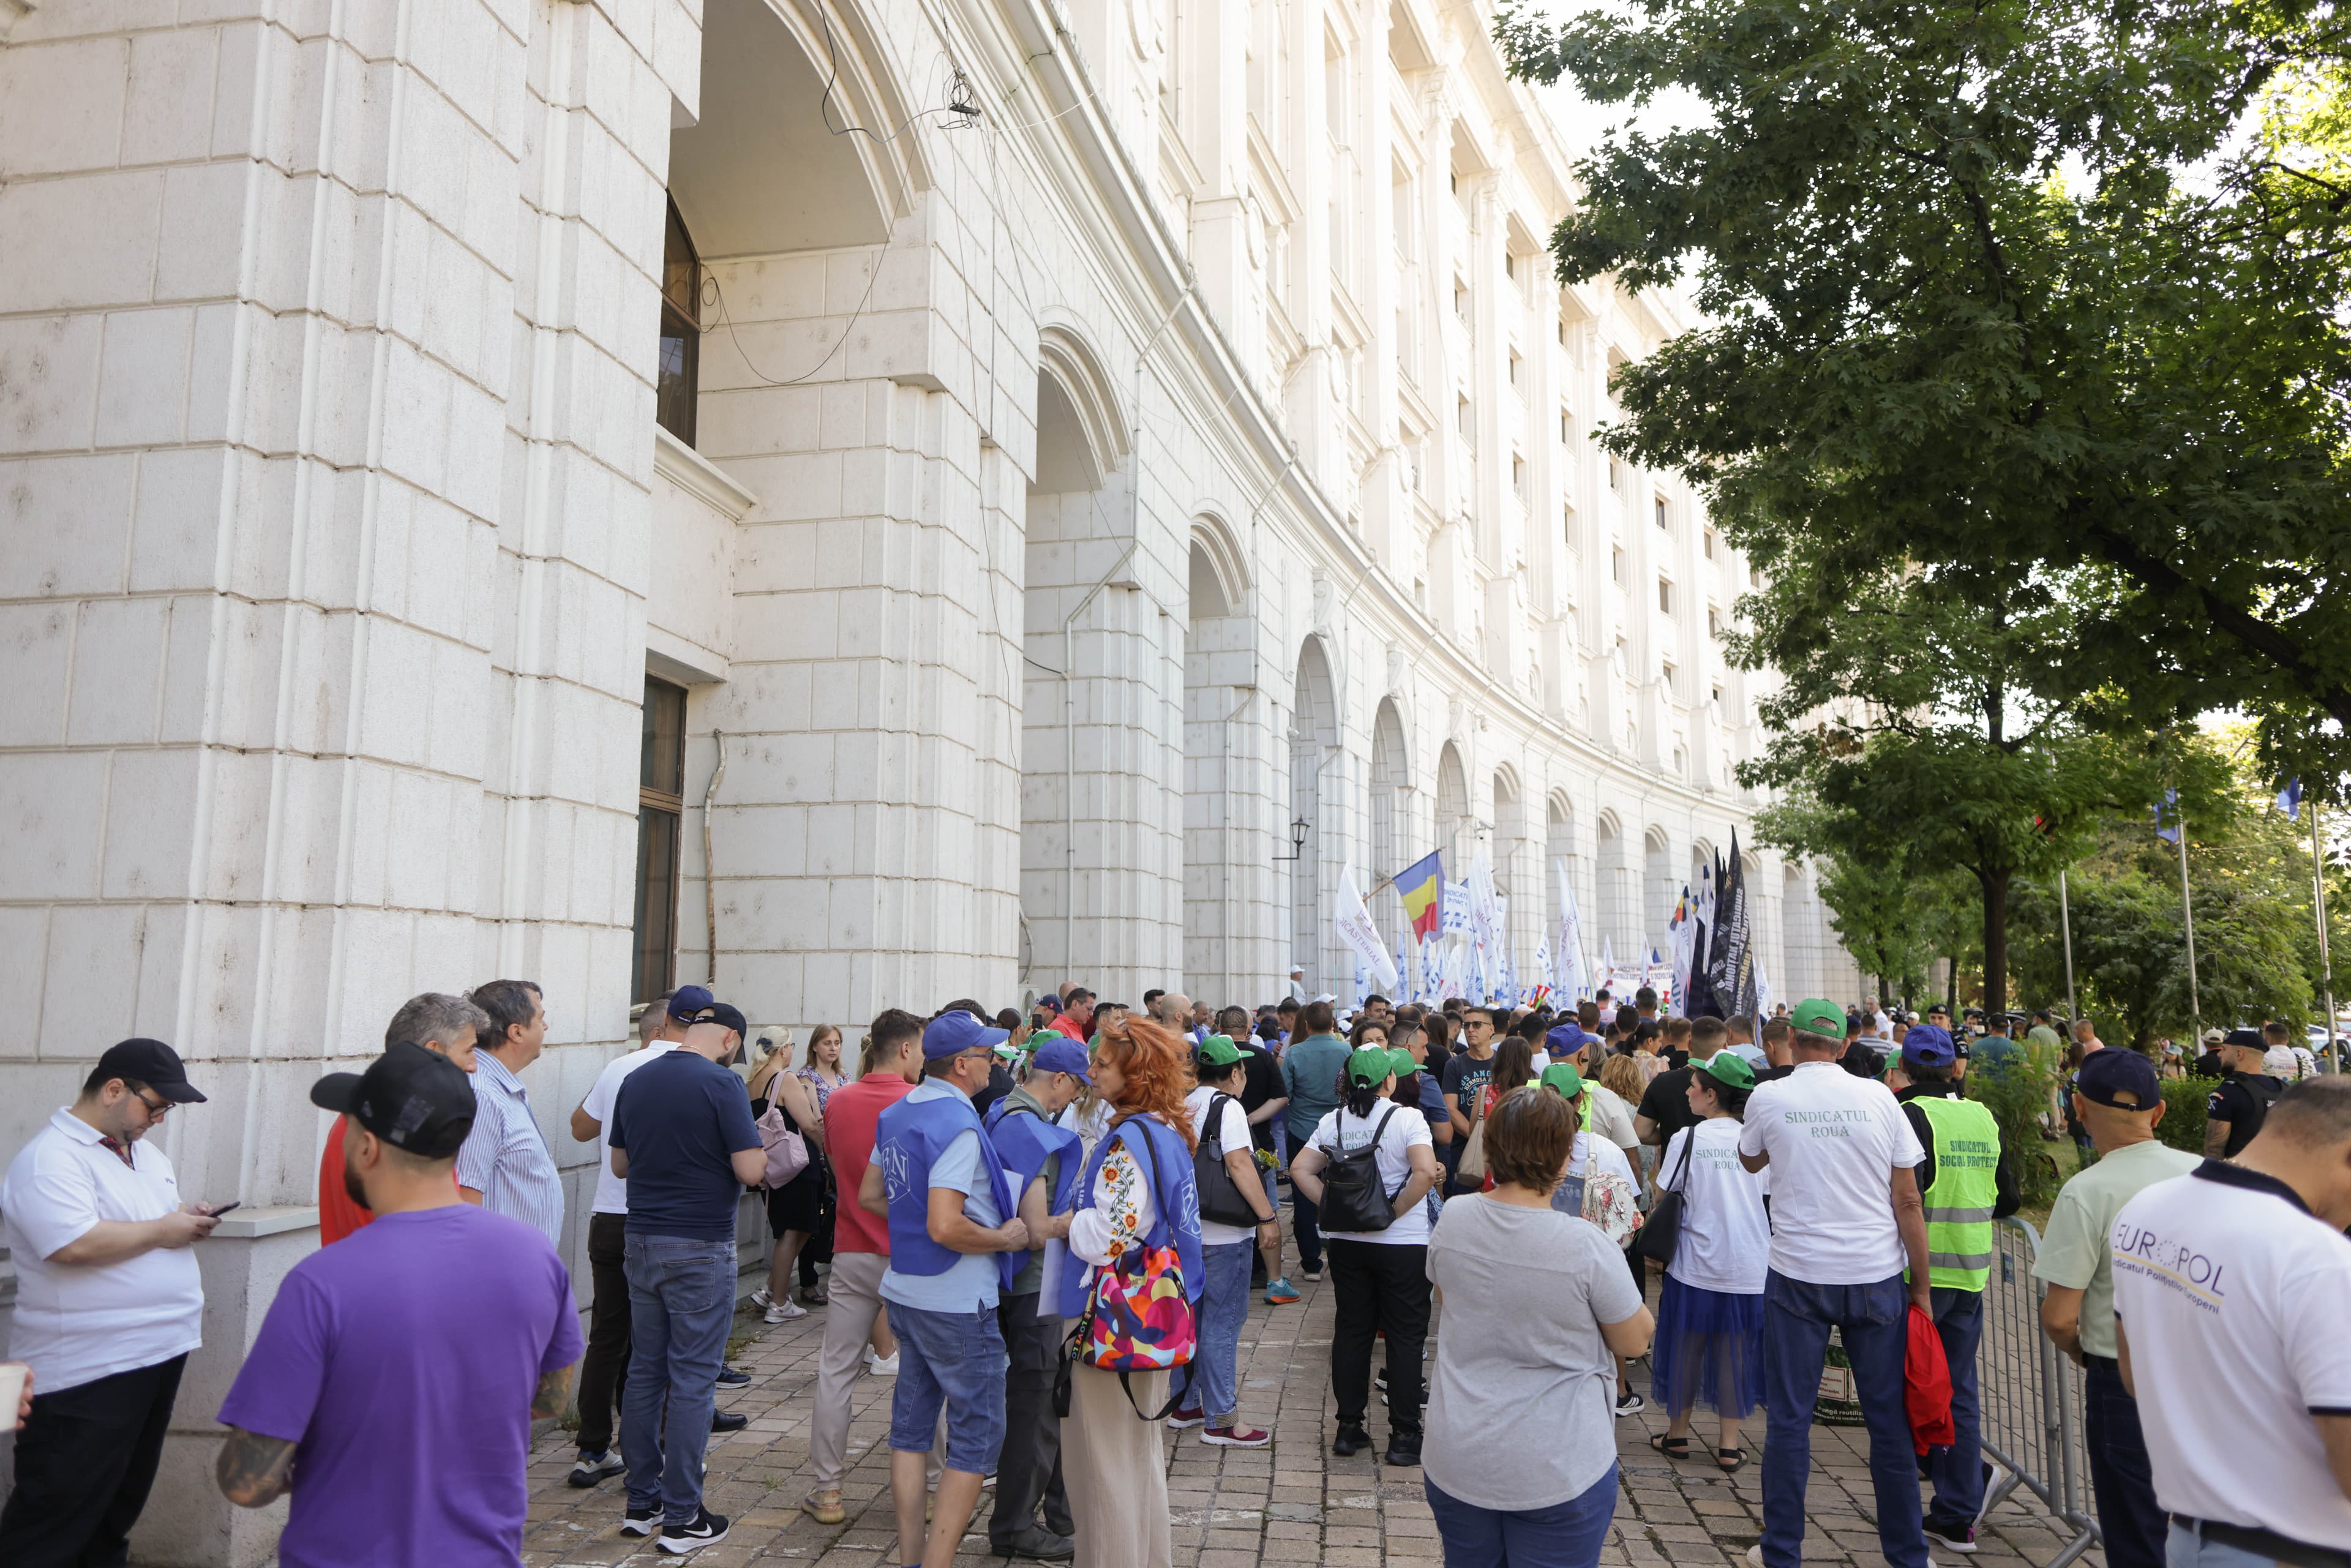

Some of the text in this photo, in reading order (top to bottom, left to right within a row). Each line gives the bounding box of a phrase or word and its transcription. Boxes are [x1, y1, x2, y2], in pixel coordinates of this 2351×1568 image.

[1464, 1077, 1487, 1091] HERMOSA
[1785, 1110, 1872, 1123] SINDICATUL
[1333, 1130, 1387, 1141] SNDICATL
[1811, 1126, 1850, 1138] ROUA
[1950, 1141, 1991, 1153] SINDICATUL
[1715, 1161, 1740, 1171] ROUA
[2115, 1225, 2224, 1297] EUROPOL
